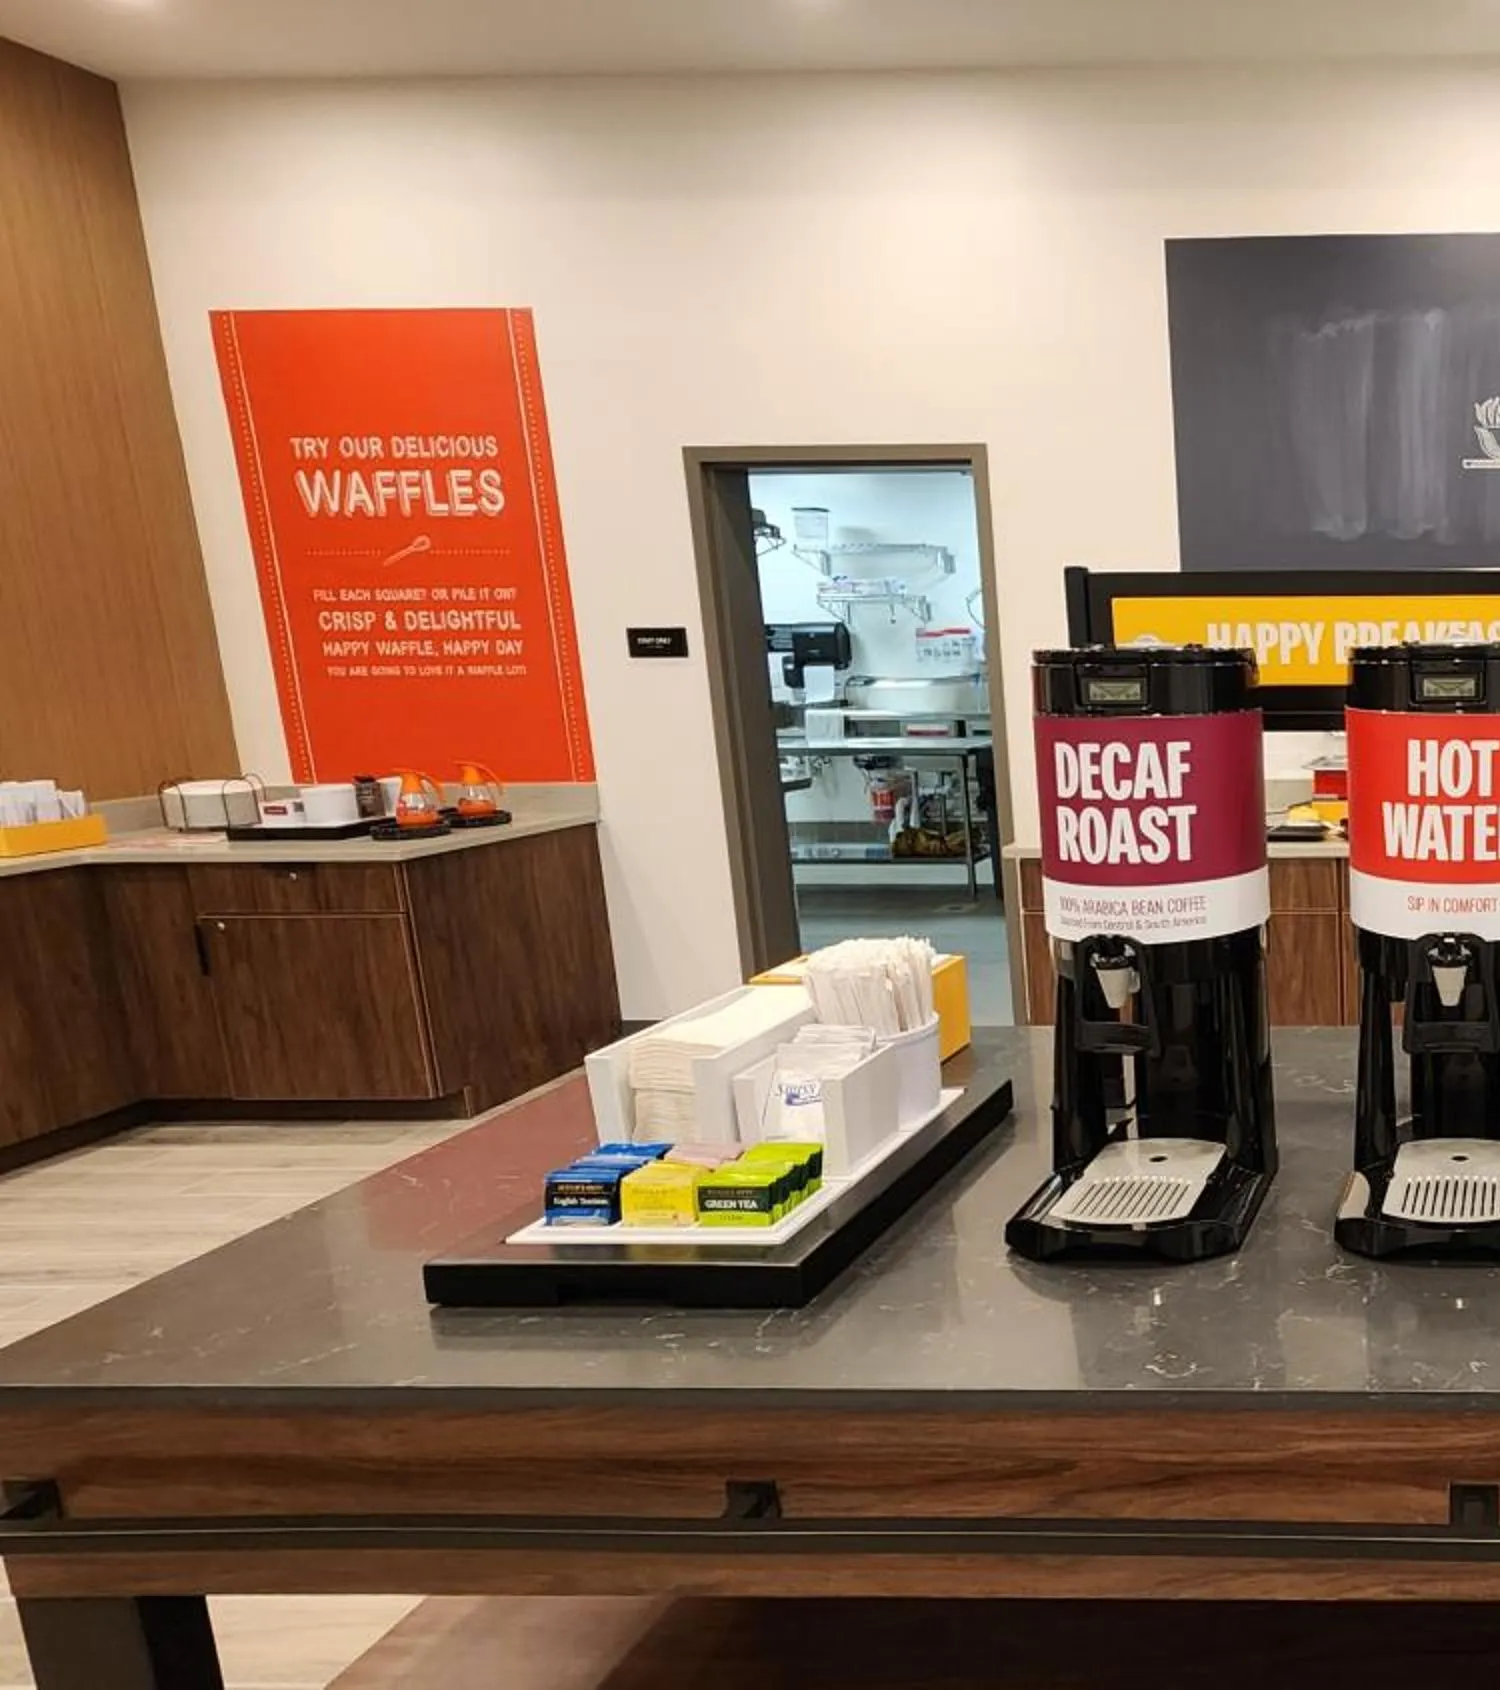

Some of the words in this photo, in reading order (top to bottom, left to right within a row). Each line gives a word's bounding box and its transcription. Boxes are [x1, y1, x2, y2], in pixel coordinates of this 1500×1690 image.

[290, 437, 329, 459] TRY
[339, 436, 384, 459] OUR
[391, 435, 498, 459] DELICIOUS
[295, 469, 505, 517] WAFFLES
[340, 588, 371, 601] EACH
[431, 588, 449, 600] OR
[479, 587, 489, 600] IT
[318, 611, 376, 631] CRISP
[384, 611, 398, 631] &
[404, 610, 521, 631] DELIGHTFUL
[323, 640, 370, 656] HAPPY
[443, 640, 494, 656] HAPPY
[495, 640, 524, 655] DAY
[1207, 621, 1325, 665] HAPPY
[1053, 740, 1192, 800] DECAF
[1407, 739, 1500, 798] HOT
[1056, 805, 1197, 865] ROAST
[1081, 898, 1128, 916] ARABICA
[1131, 899, 1164, 916] BEAN
[1407, 895, 1424, 911] SIP
[1427, 897, 1439, 912] IN
[1443, 897, 1498, 913] COMFORT
[704, 1200, 736, 1209] GREEN
[738, 1200, 758, 1210] TEA
